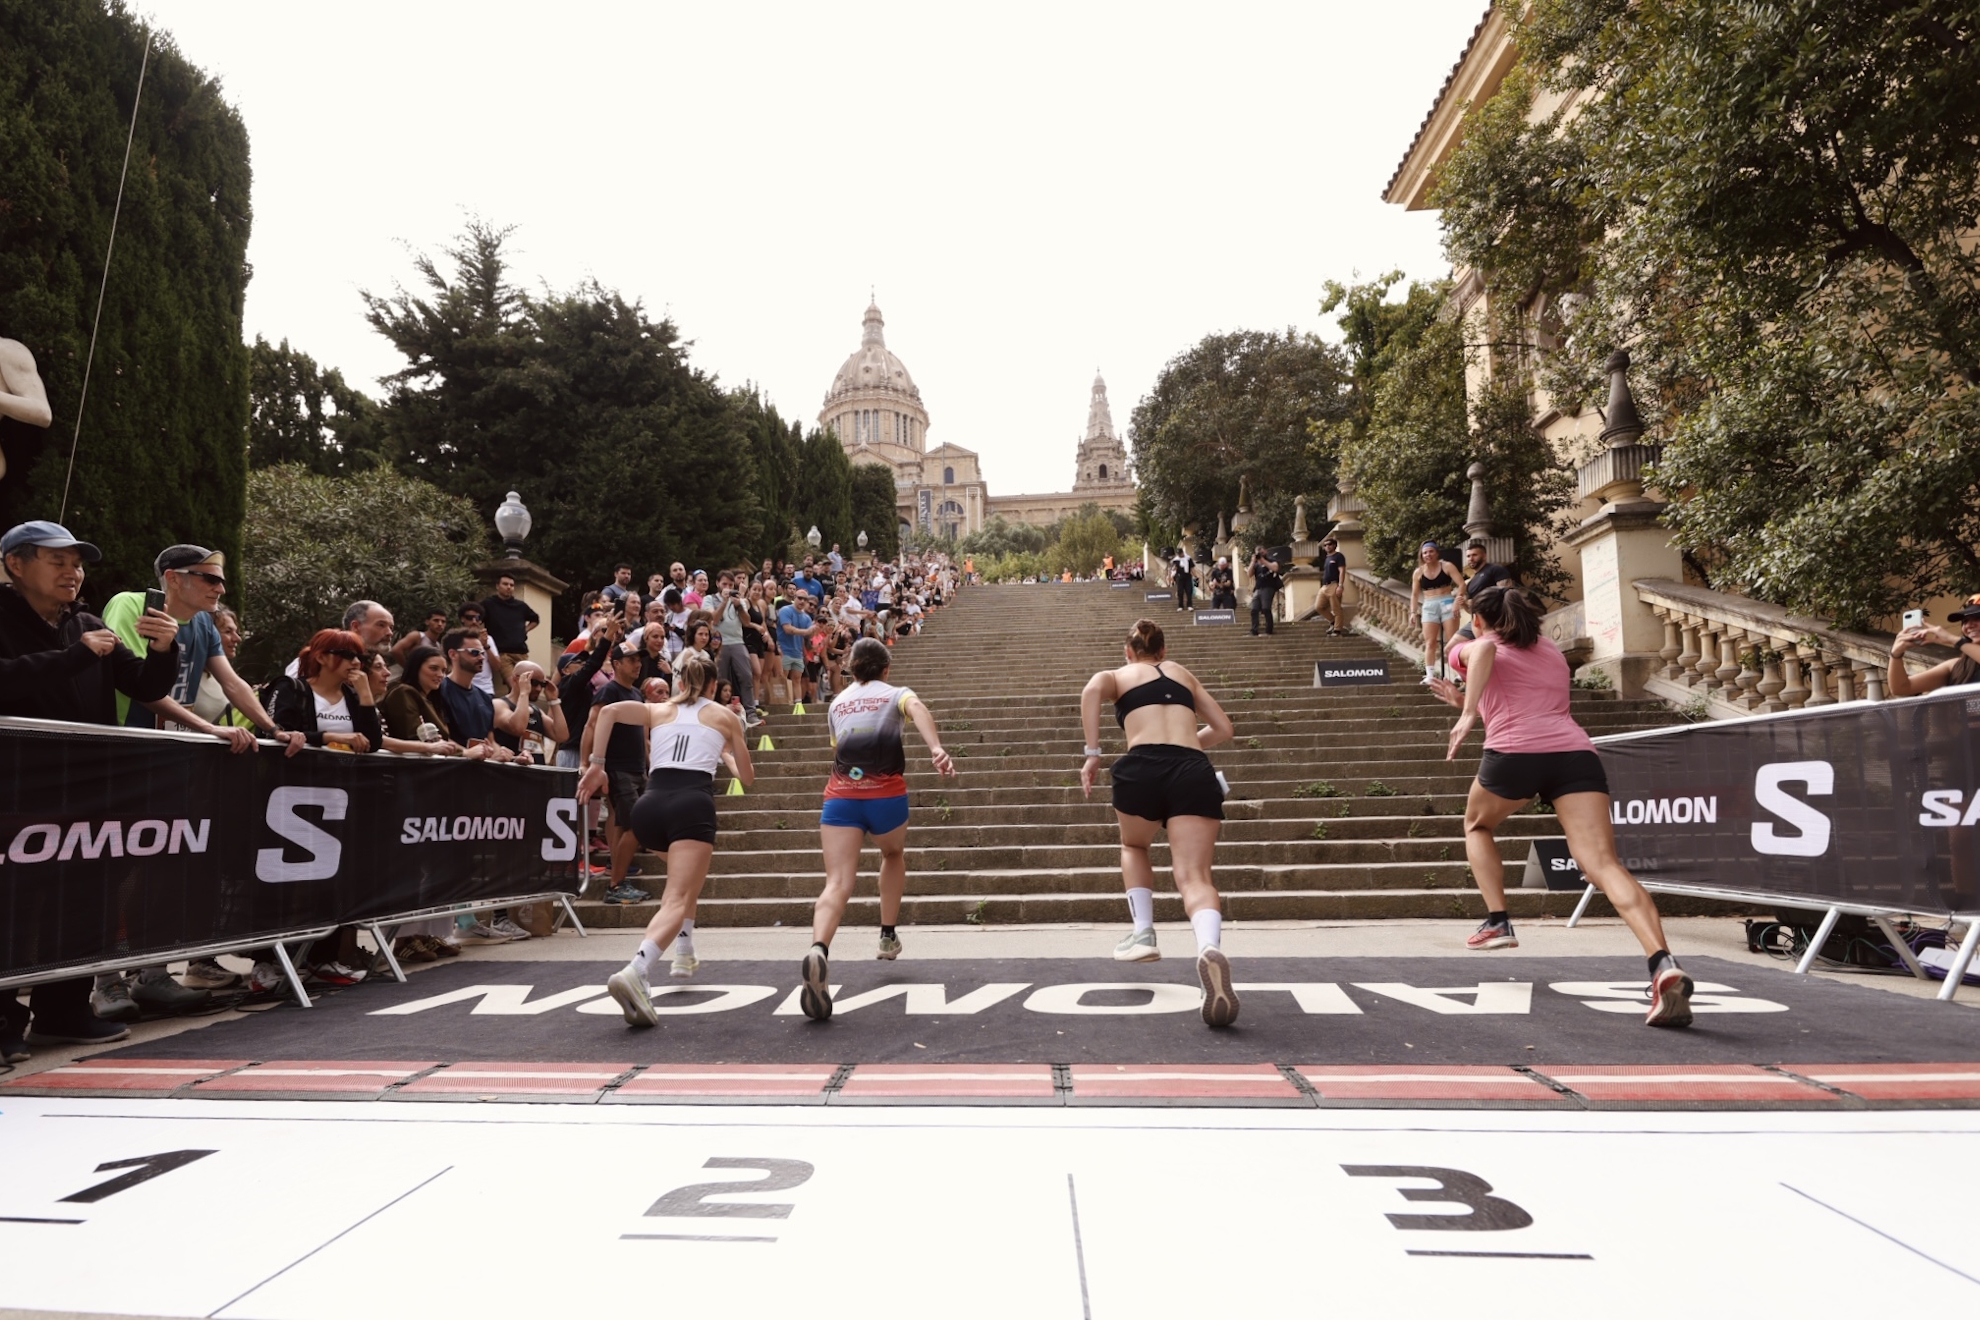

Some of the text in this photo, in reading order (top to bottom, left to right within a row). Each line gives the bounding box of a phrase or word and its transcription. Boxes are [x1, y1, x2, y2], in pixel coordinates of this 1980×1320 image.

[1324, 669, 1384, 678] SALOMON
[838, 704, 879, 718] MOLINS
[400, 816, 525, 845] SALOMON
[1610, 796, 1717, 825] LOMON
[1751, 760, 1834, 857] S
[0, 819, 211, 865] OMON
[255, 786, 348, 883] S
[57, 1149, 220, 1204] 1
[643, 1157, 814, 1220] 2
[1339, 1164, 1534, 1231] 3
